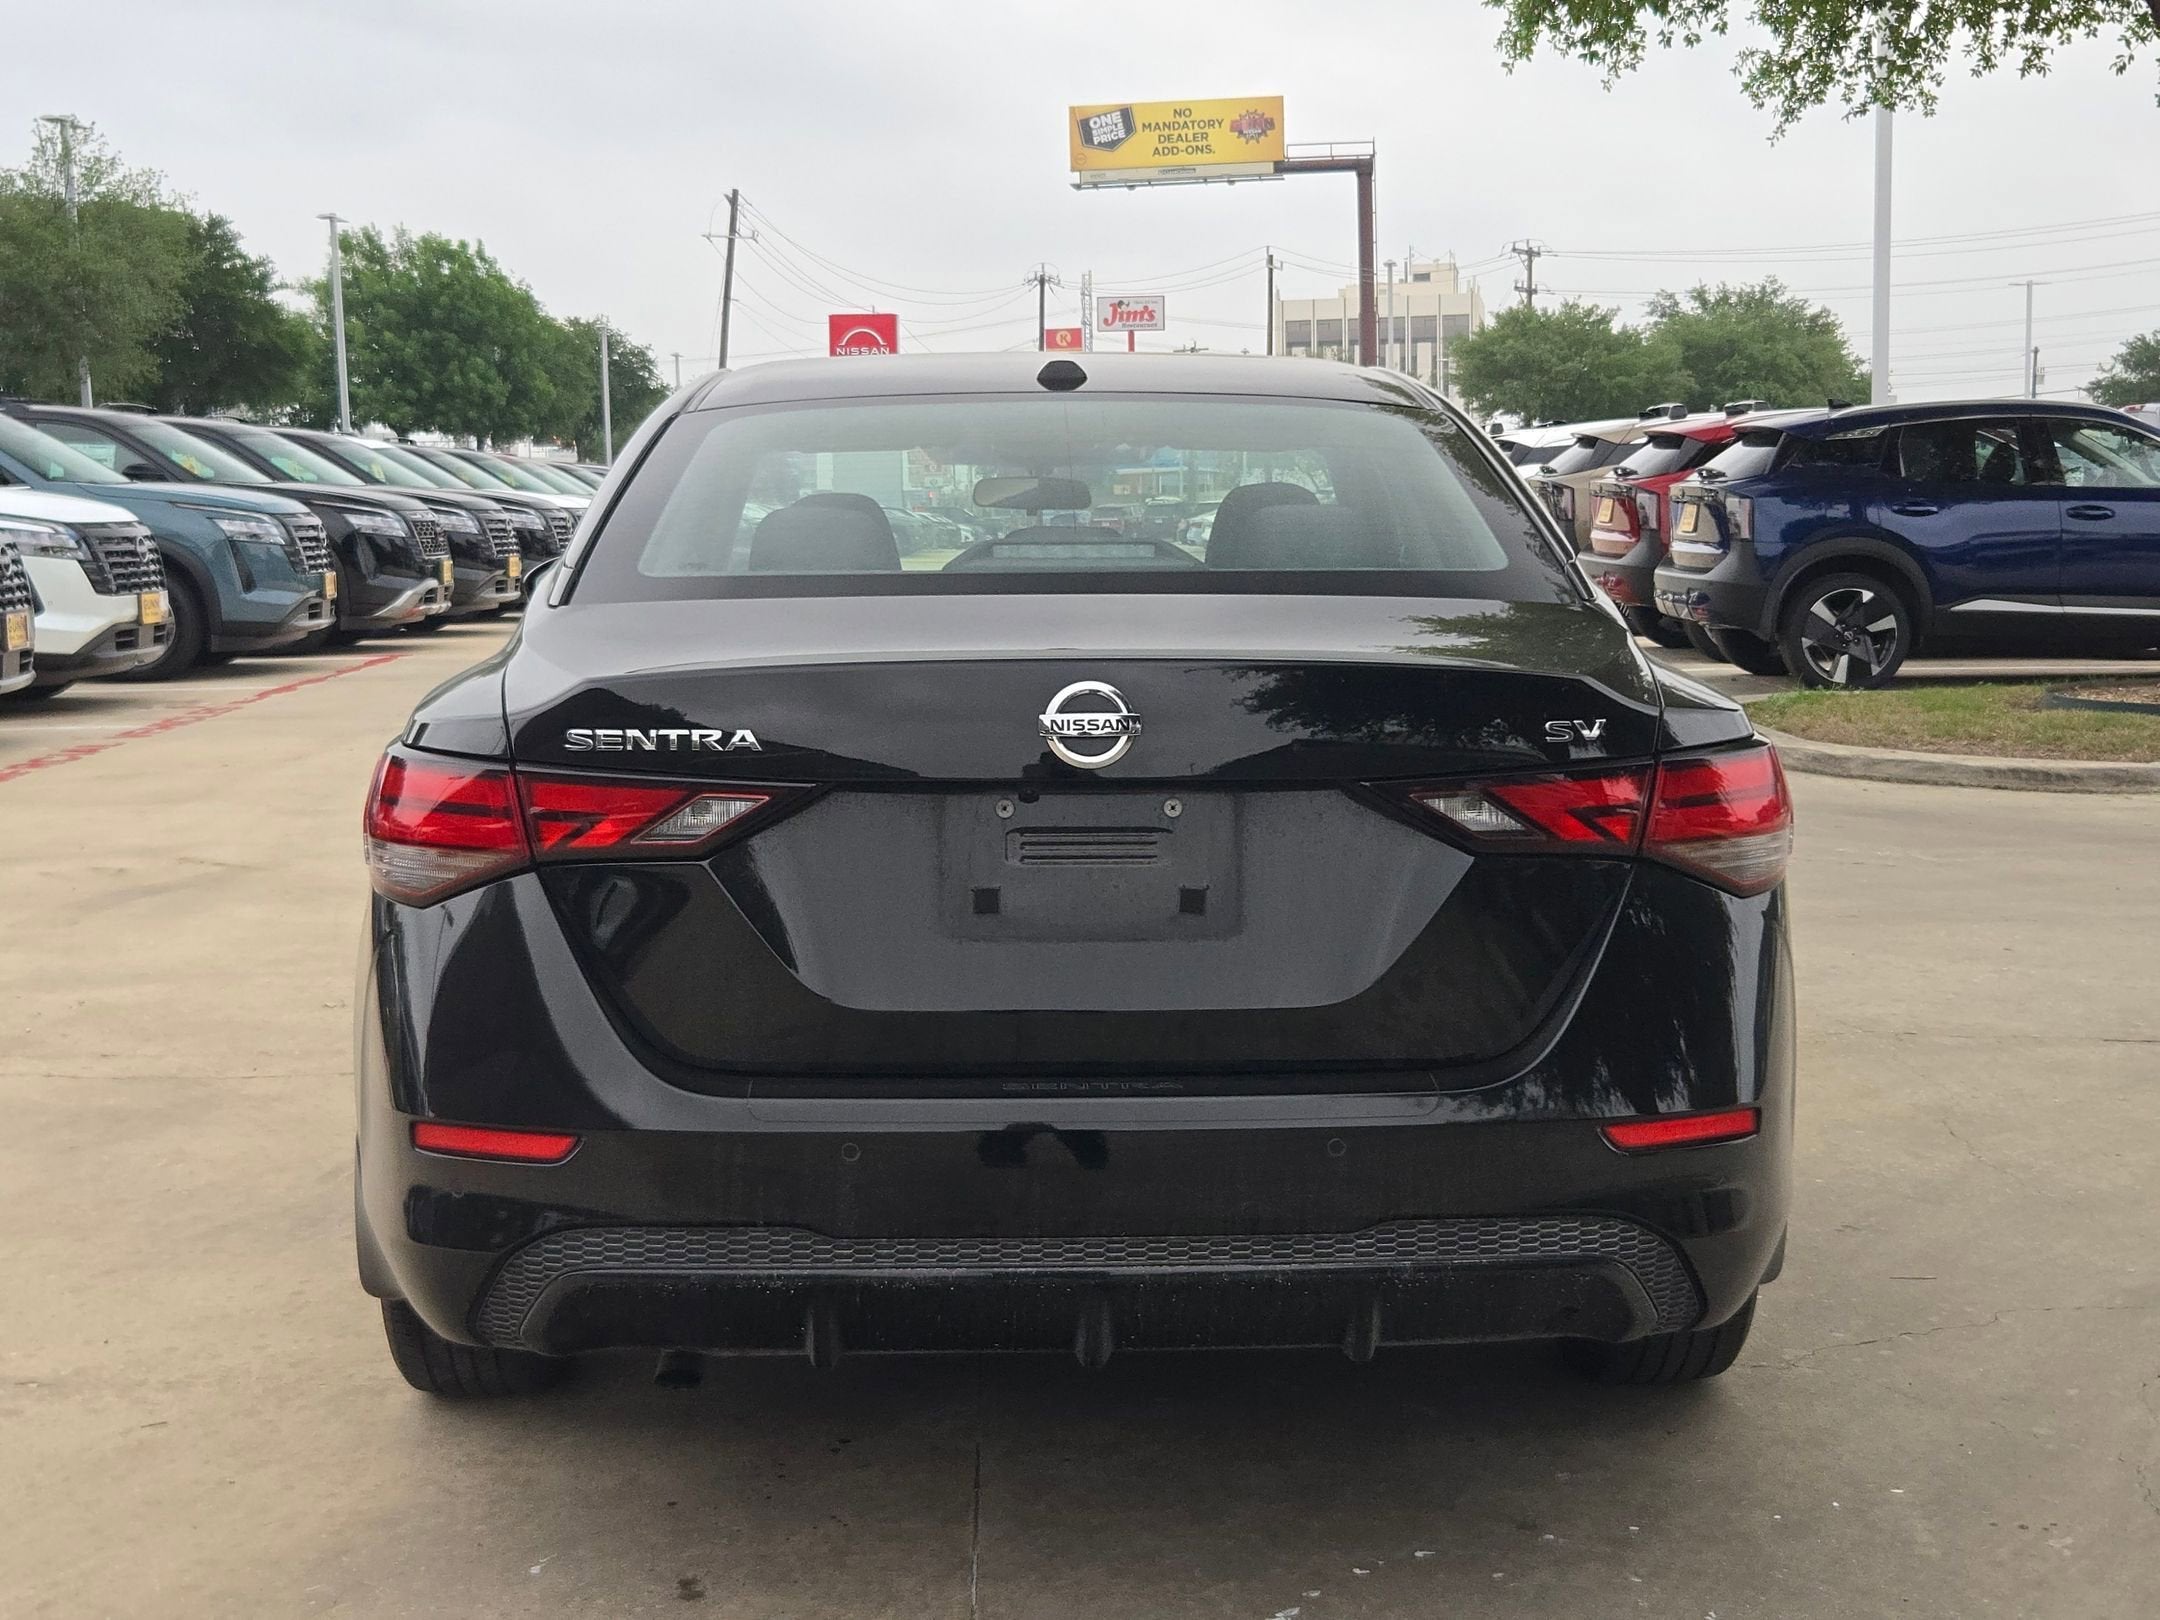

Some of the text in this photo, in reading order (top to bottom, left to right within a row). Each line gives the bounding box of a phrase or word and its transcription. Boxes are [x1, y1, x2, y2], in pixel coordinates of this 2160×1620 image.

[1089, 111, 1122, 129] ONE
[1173, 108, 1192, 119] NO
[1091, 122, 1125, 137] SIMPLE
[1141, 119, 1224, 132] MANDATORY
[1093, 131, 1126, 145] PRICE
[1157, 132, 1209, 144] DEALER
[1152, 145, 1216, 157] ADD-ONS.
[1103, 302, 1157, 327] Jim's
[836, 346, 890, 356] NISSAN
[1050, 719, 1130, 731] NISSAN
[1545, 718, 1607, 742] SV
[564, 728, 763, 751] SENTRA
